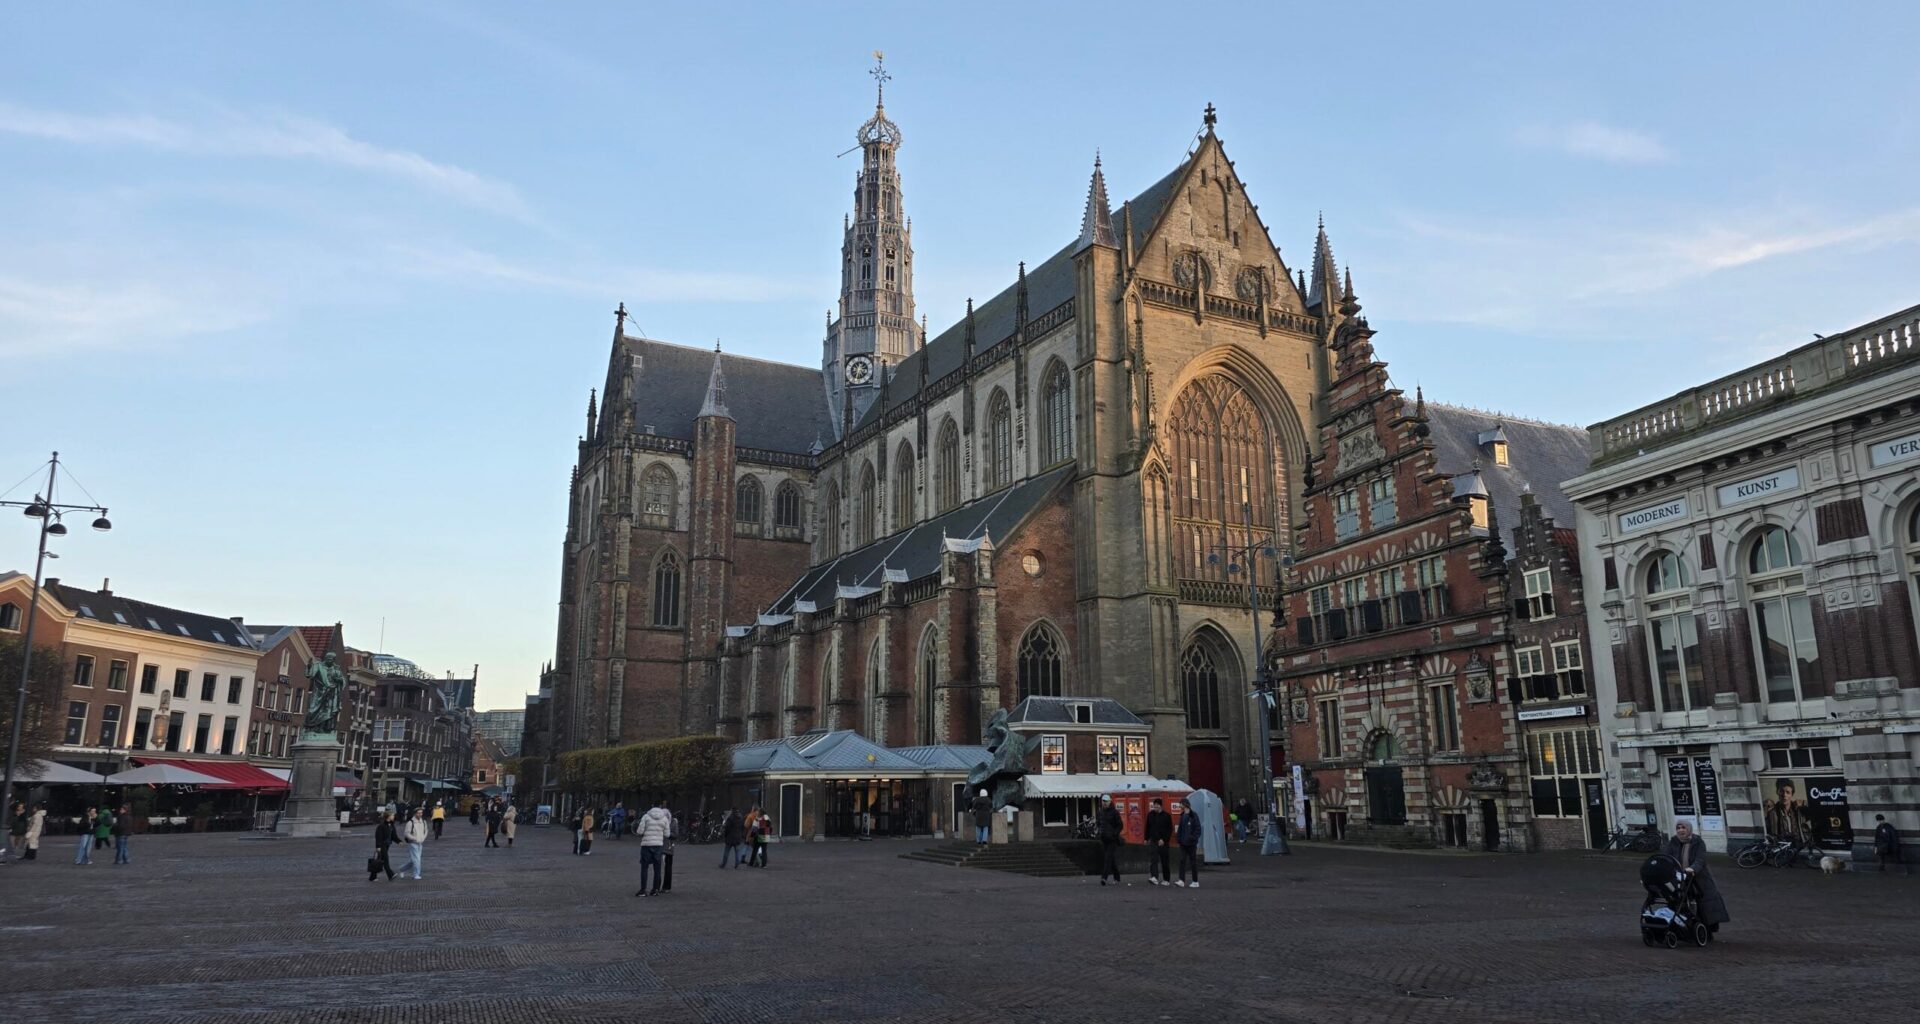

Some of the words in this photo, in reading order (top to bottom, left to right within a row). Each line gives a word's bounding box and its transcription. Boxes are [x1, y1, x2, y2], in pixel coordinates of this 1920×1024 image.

[1889, 439, 1920, 457] VER
[1737, 477, 1779, 497] KUNST
[1627, 503, 1680, 527] MODERNE
